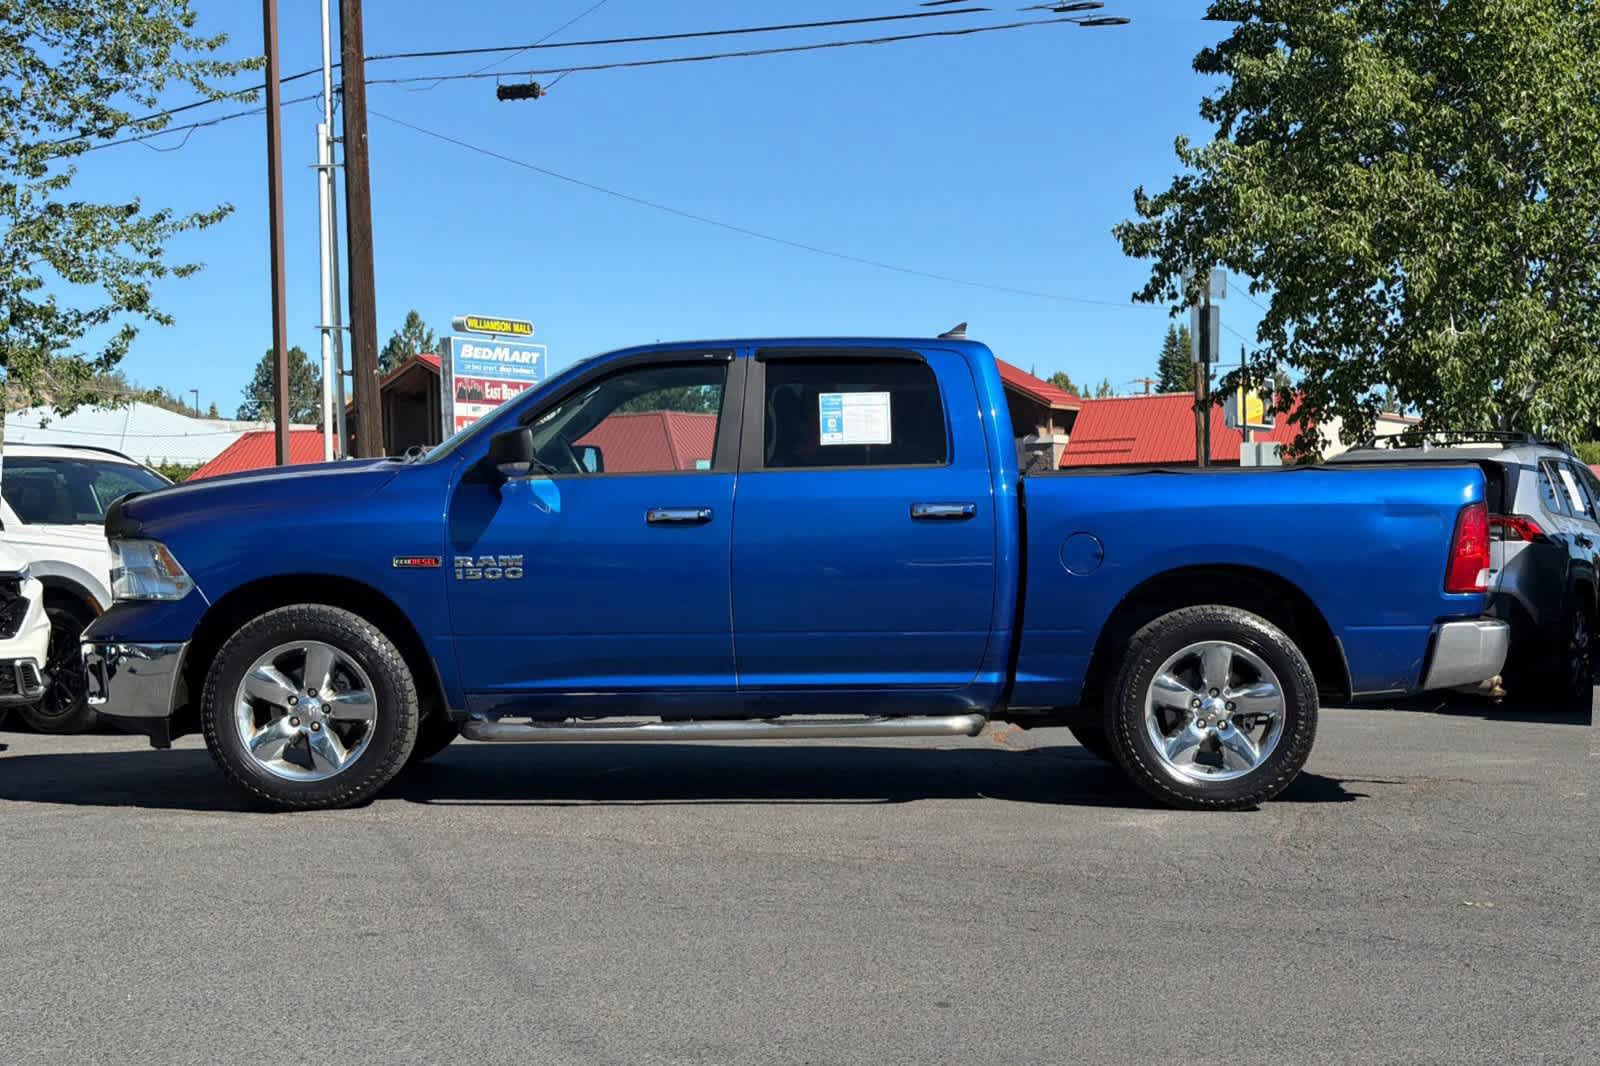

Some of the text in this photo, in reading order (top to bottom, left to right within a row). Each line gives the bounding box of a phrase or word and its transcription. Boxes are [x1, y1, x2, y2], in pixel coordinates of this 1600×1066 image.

[467, 319, 531, 335] WILLIAMSON MALL
[454, 555, 523, 567] RAM
[455, 567, 524, 580] 1500
